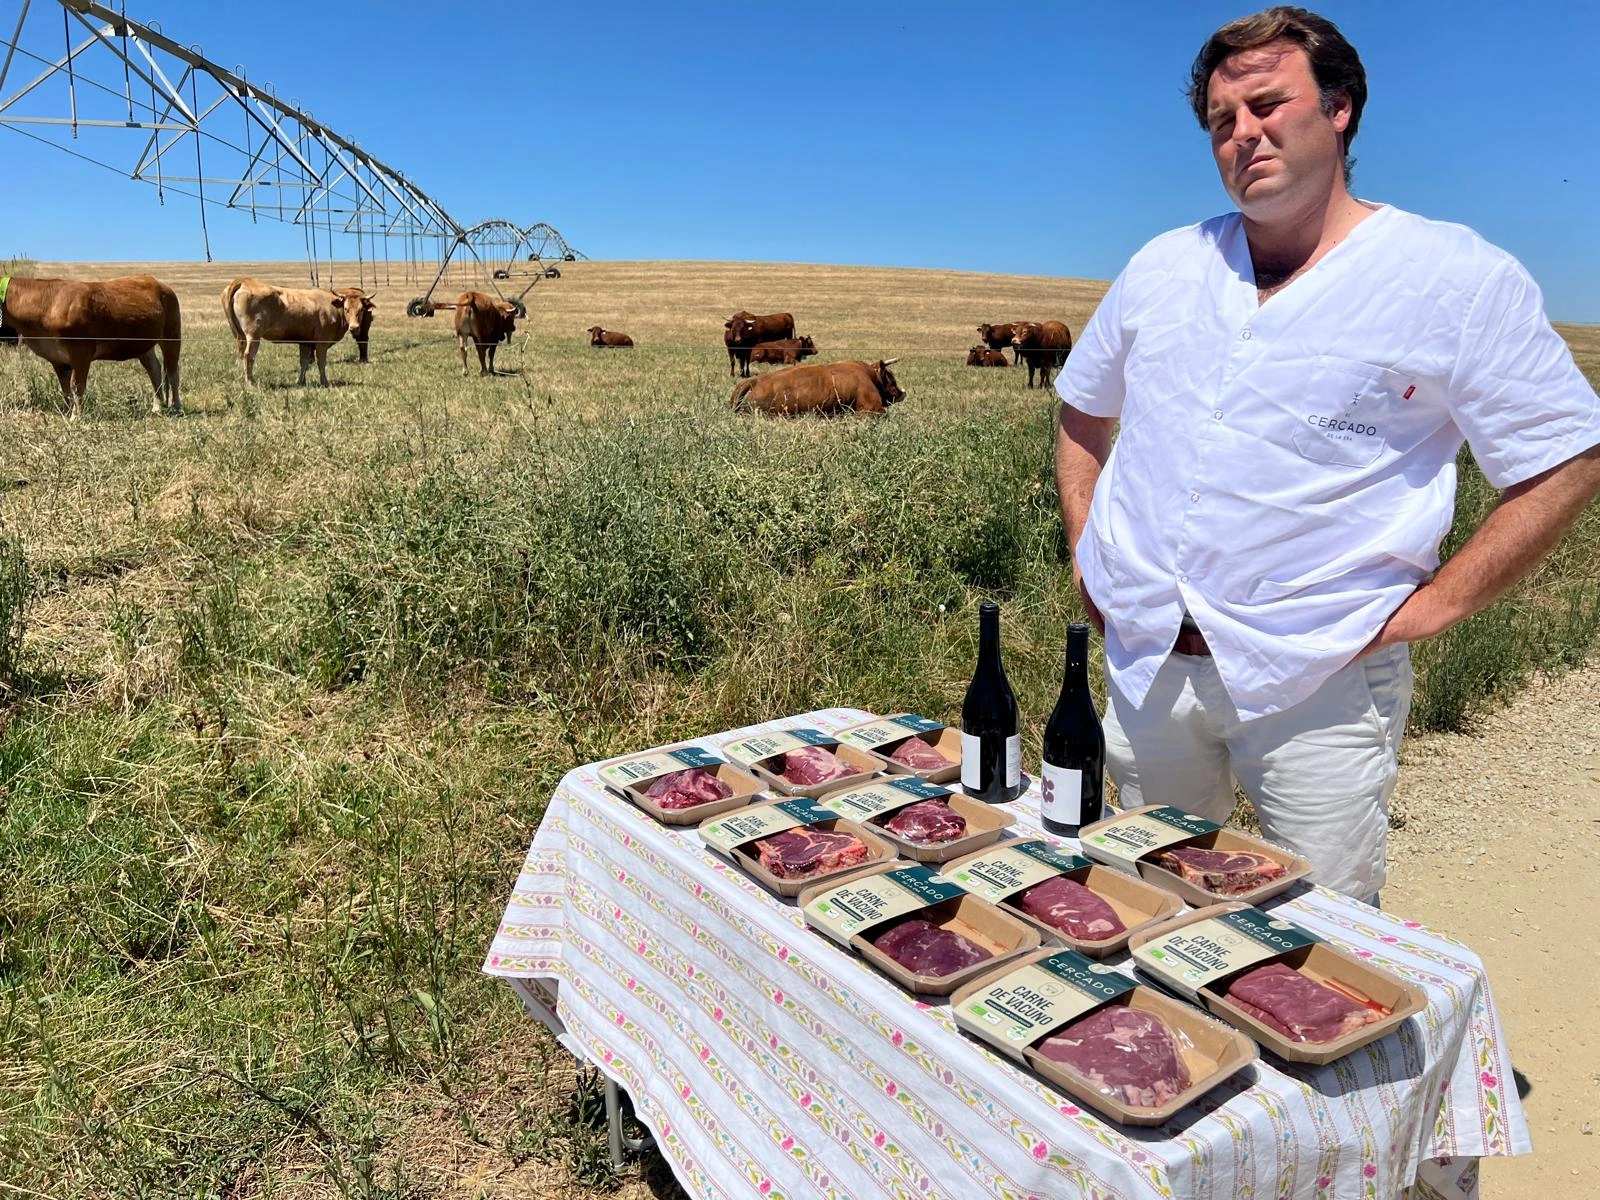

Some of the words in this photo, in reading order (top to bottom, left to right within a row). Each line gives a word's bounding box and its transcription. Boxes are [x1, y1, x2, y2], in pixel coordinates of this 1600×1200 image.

[1308, 414, 1376, 436] CERCADO
[1125, 825, 1158, 839] CARNE
[1152, 810, 1206, 833] CERCADO
[1107, 826, 1122, 836] DE
[1120, 831, 1158, 847] VACUNO
[991, 860, 1024, 877] CARNE
[1022, 843, 1075, 870] CERCADO
[895, 870, 944, 900] CERCADO
[972, 861, 988, 871] DE
[985, 866, 1023, 888] VACUNO
[836, 889, 852, 900] DE
[849, 896, 883, 920] VACUNO
[856, 888, 888, 909] CARNE
[1229, 913, 1293, 948] CERCADO
[1168, 936, 1187, 949] DE
[1184, 942, 1229, 971] VACUNO
[1191, 935, 1231, 958] CARNE
[1048, 958, 1115, 995] CERCADO
[988, 987, 1011, 1001] DE
[1006, 996, 1054, 1026] VACUNO
[1012, 985, 1055, 1012] CARNE
